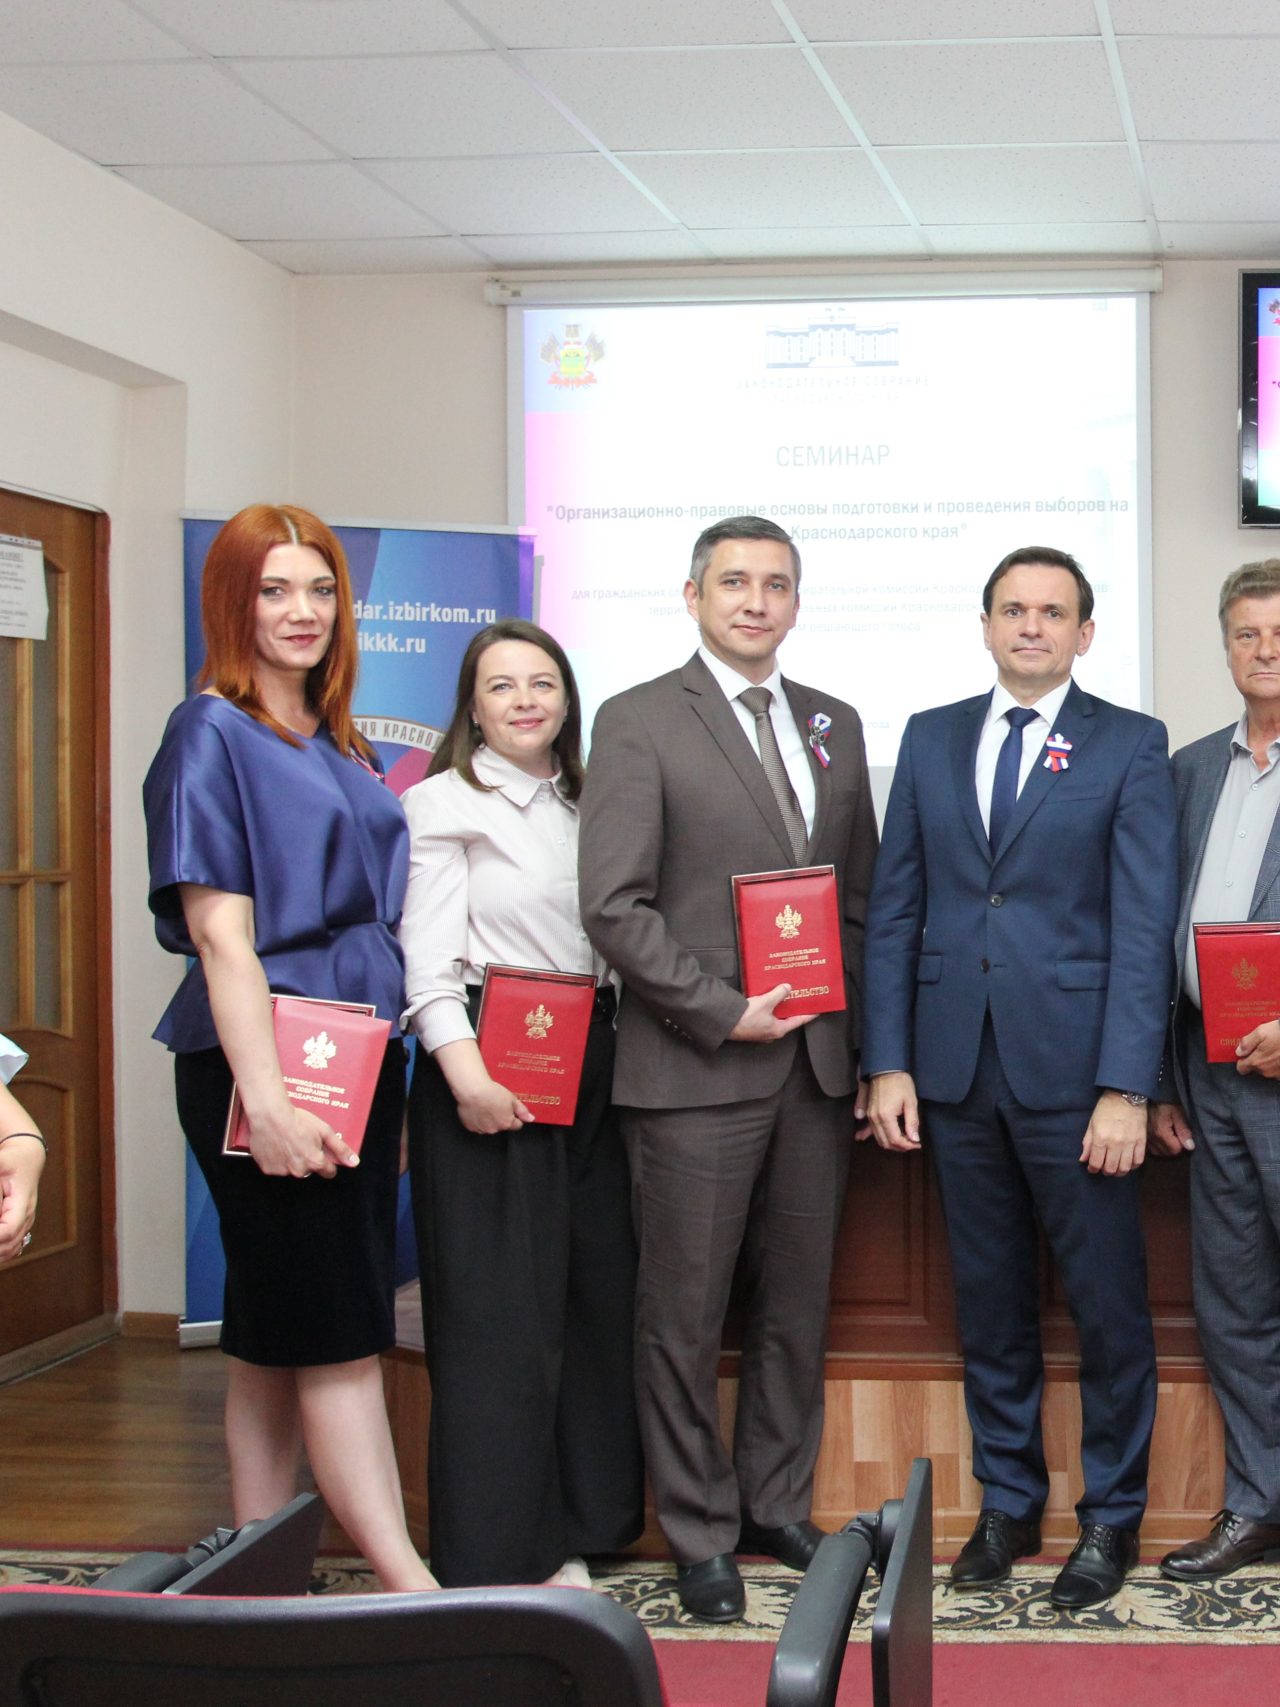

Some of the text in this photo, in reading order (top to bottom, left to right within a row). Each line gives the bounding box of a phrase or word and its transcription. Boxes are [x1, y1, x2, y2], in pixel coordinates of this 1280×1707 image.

[775, 444, 890, 467] СЕМИНАР
[770, 502, 828, 516] основы
[832, 501, 919, 516] подготовки
[923, 501, 932, 514] и
[937, 499, 1031, 515] проведения
[1035, 497, 1106, 514] выборов
[1110, 499, 1129, 513] на
[790, 525, 918, 542] Краснодарского
